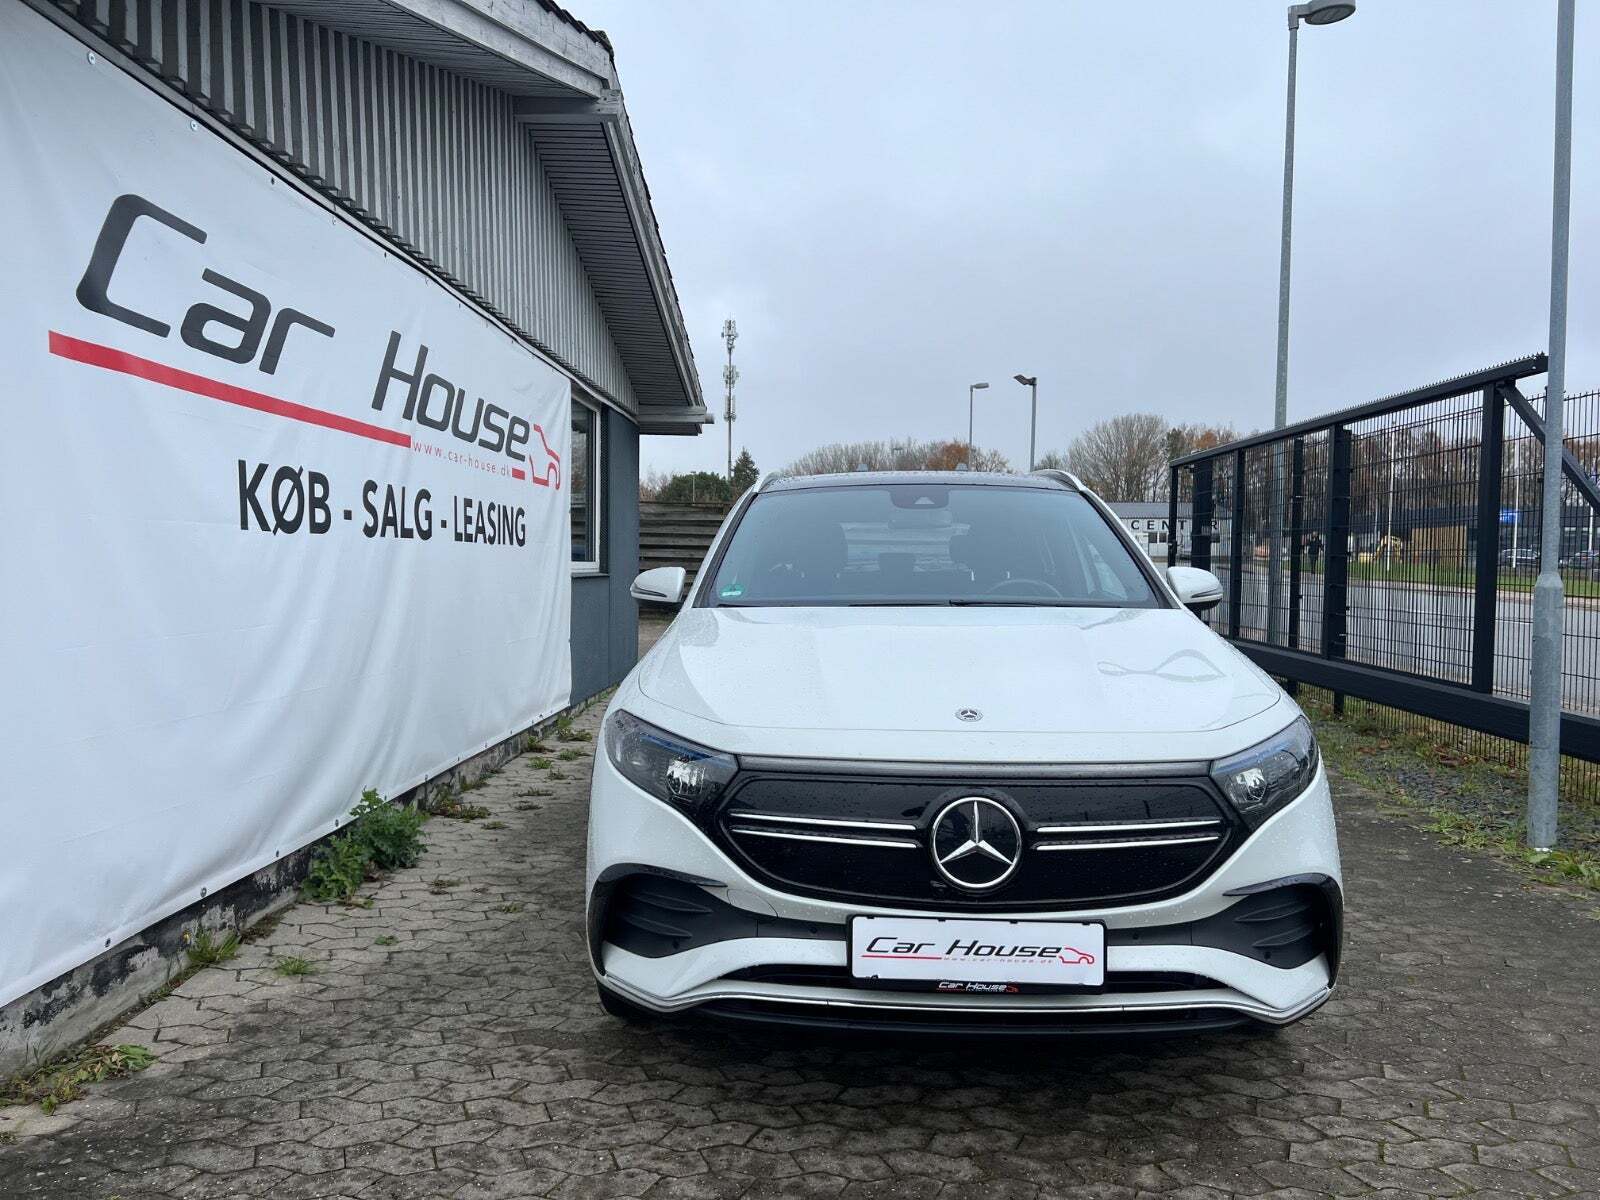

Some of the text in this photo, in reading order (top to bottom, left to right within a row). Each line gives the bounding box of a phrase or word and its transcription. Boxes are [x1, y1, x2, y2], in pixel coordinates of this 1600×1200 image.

[76, 194, 530, 462] Car House
[413, 442, 510, 476] www.car-house.dk
[238, 459, 331, 536] KØB
[362, 479, 433, 541] SALG
[454, 495, 526, 547] LEASING
[1131, 520, 1218, 530] CENTR
[866, 937, 1062, 958] Car House
[938, 981, 964, 989] Car
[965, 982, 1007, 991] House
